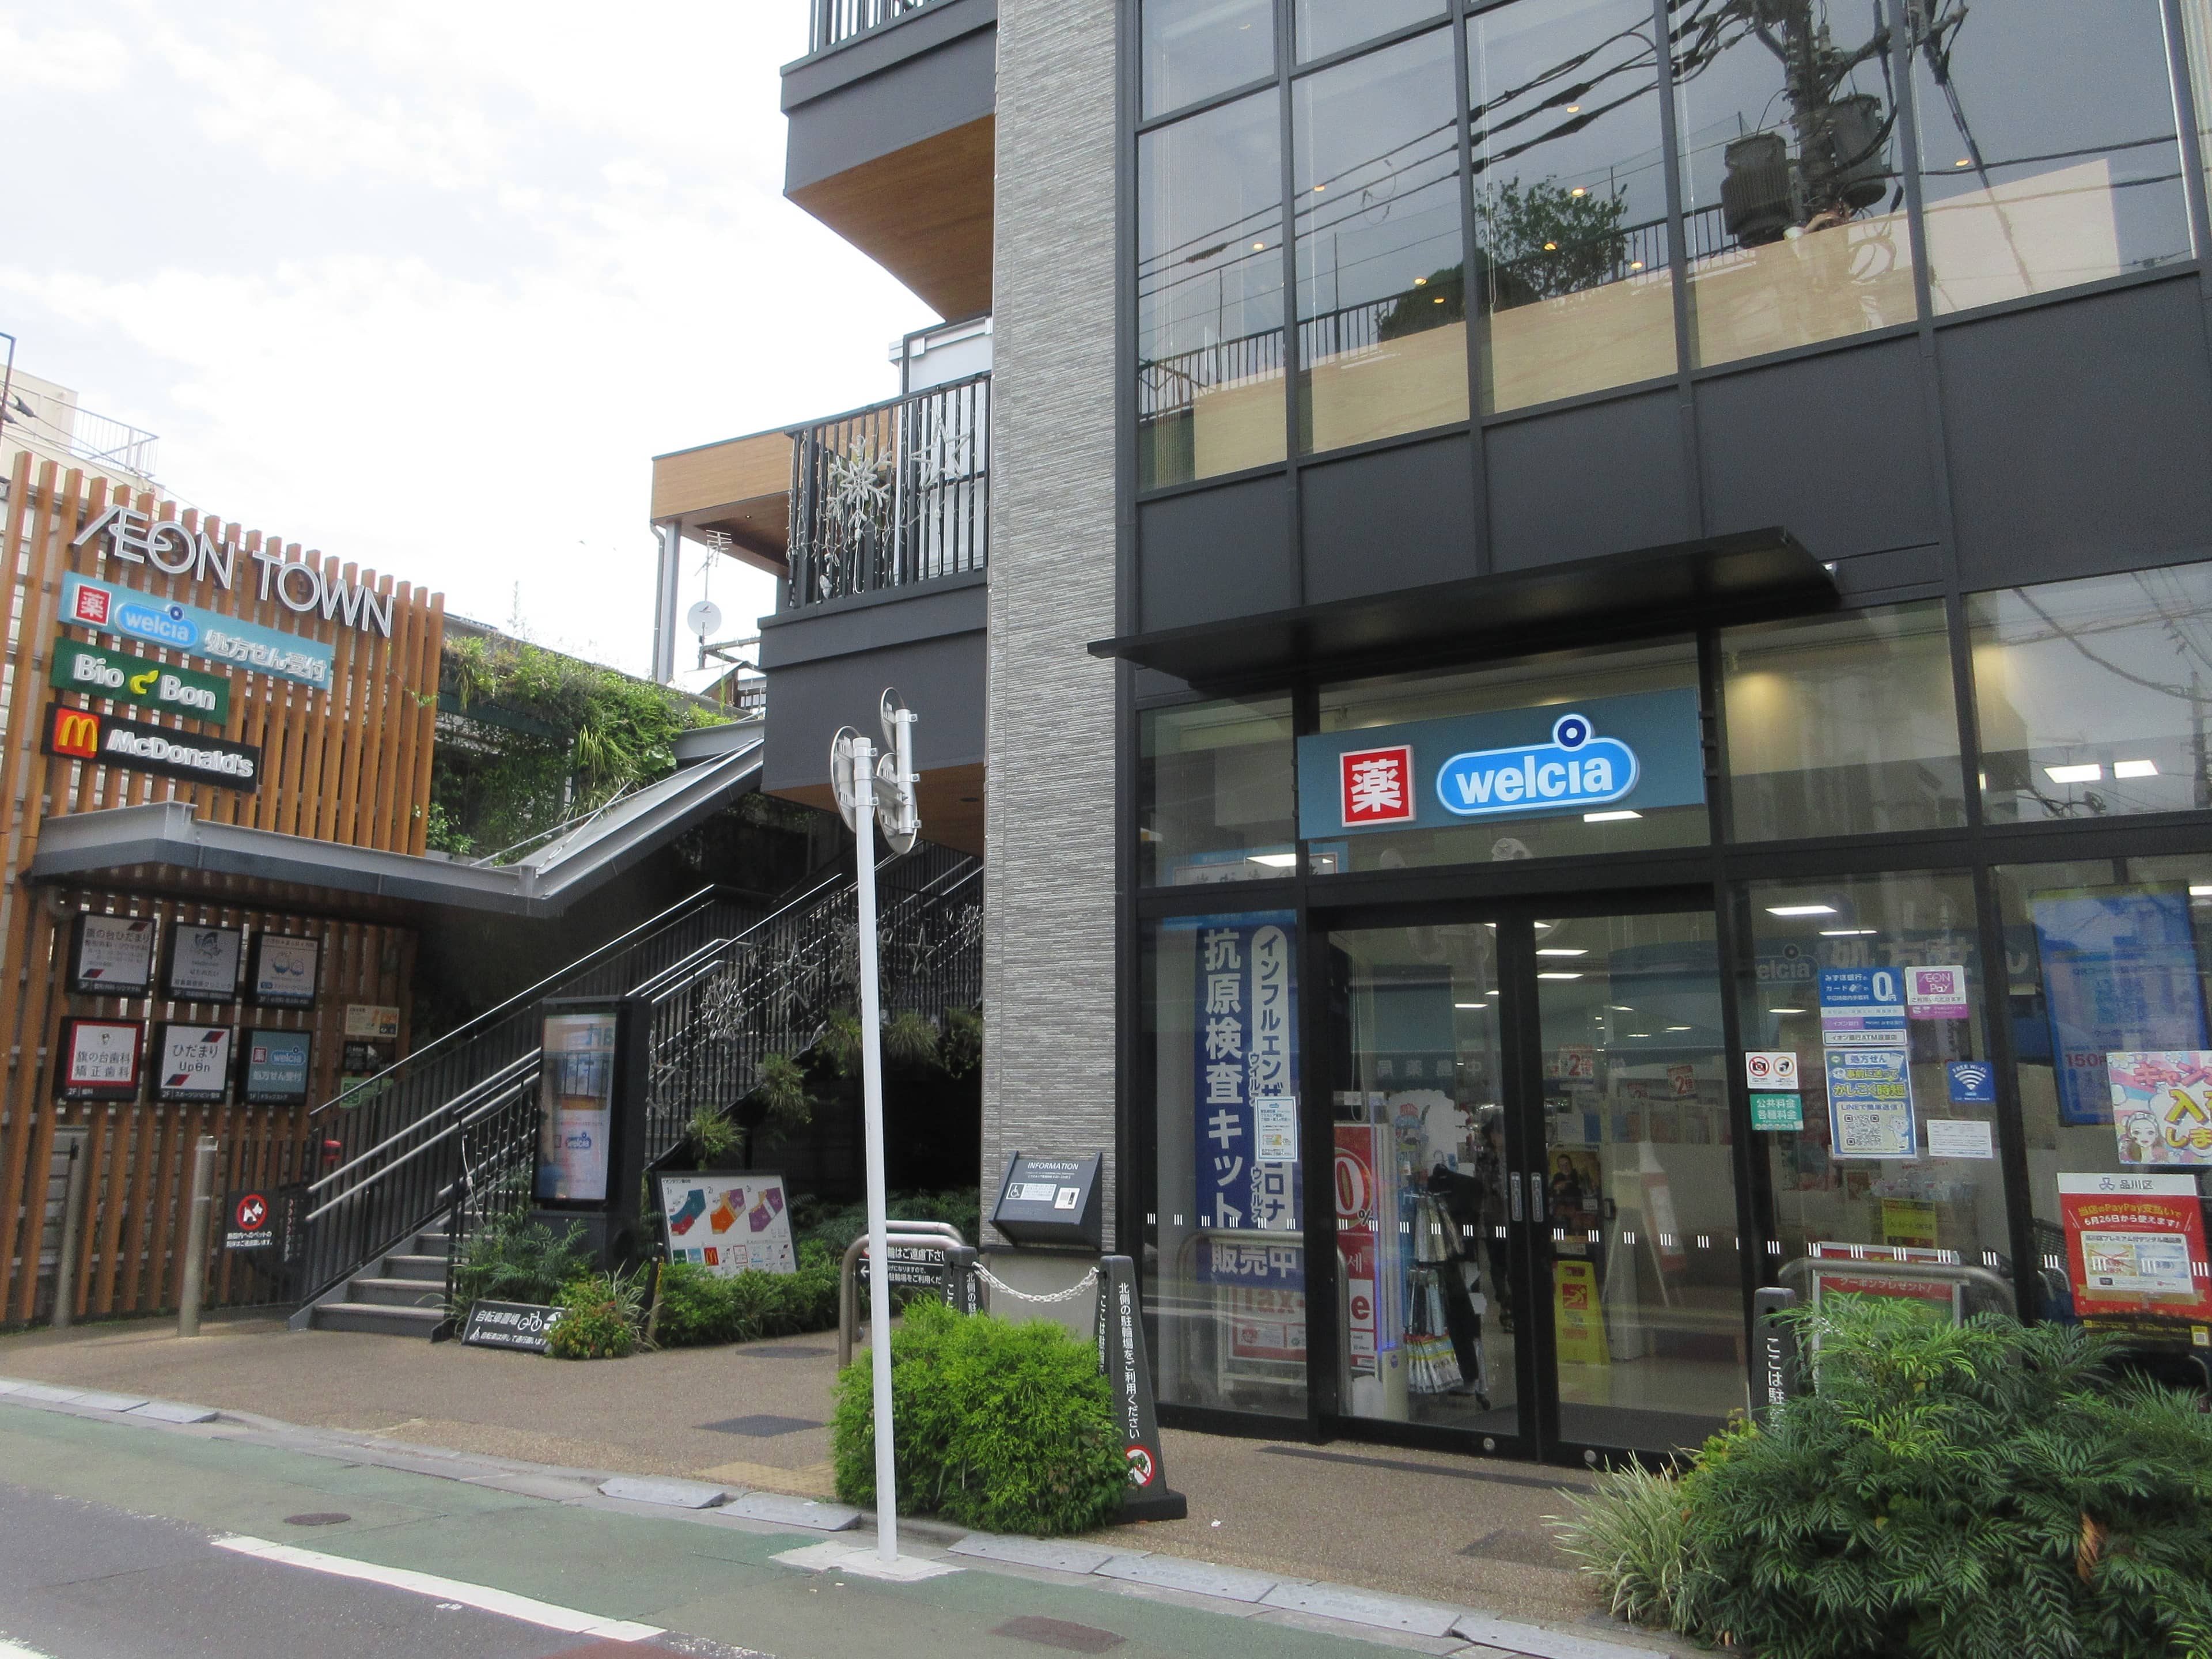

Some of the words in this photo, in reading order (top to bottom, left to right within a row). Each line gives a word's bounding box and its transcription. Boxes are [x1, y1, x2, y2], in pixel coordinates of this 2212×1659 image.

[78, 588, 108, 620] 薬
[251, 549, 393, 638] TOWN
[123, 605, 191, 643] welcia
[204, 629, 328, 683] 処方せん受付
[73, 653, 125, 689] Bio
[158, 675, 217, 711] Bon
[106, 729, 255, 778] McDonald's
[1351, 759, 1402, 813] 薬
[1455, 742, 1614, 805] welcia
[1757, 953, 1810, 978] elcia
[1929, 982, 1952, 993] Pay
[77, 1051, 130, 1065] 旗の台歯科
[173, 1044, 218, 1059] ひだまり
[1850, 1055, 1886, 1063] 処方せん
[1204, 928, 1244, 1228] 抗原検査キット
[1952, 1064, 1968, 1073] FREE
[1756, 1098, 1796, 1108] 公共料金
[1833, 1083, 1906, 1097] かしこく時短
[1027, 1162, 1079, 1171] INFORMATION
[1265, 1162, 1286, 1222] ロナ
[2120, 1179, 2153, 1190] 品川区
[2085, 1214, 2180, 1228] 6月26日から使えます!
[1211, 1247, 1297, 1278] 販売中
[475, 1309, 521, 1325] 自転車置場
[1119, 1282, 1140, 1440] 北側の駐輪場をご利用ください
